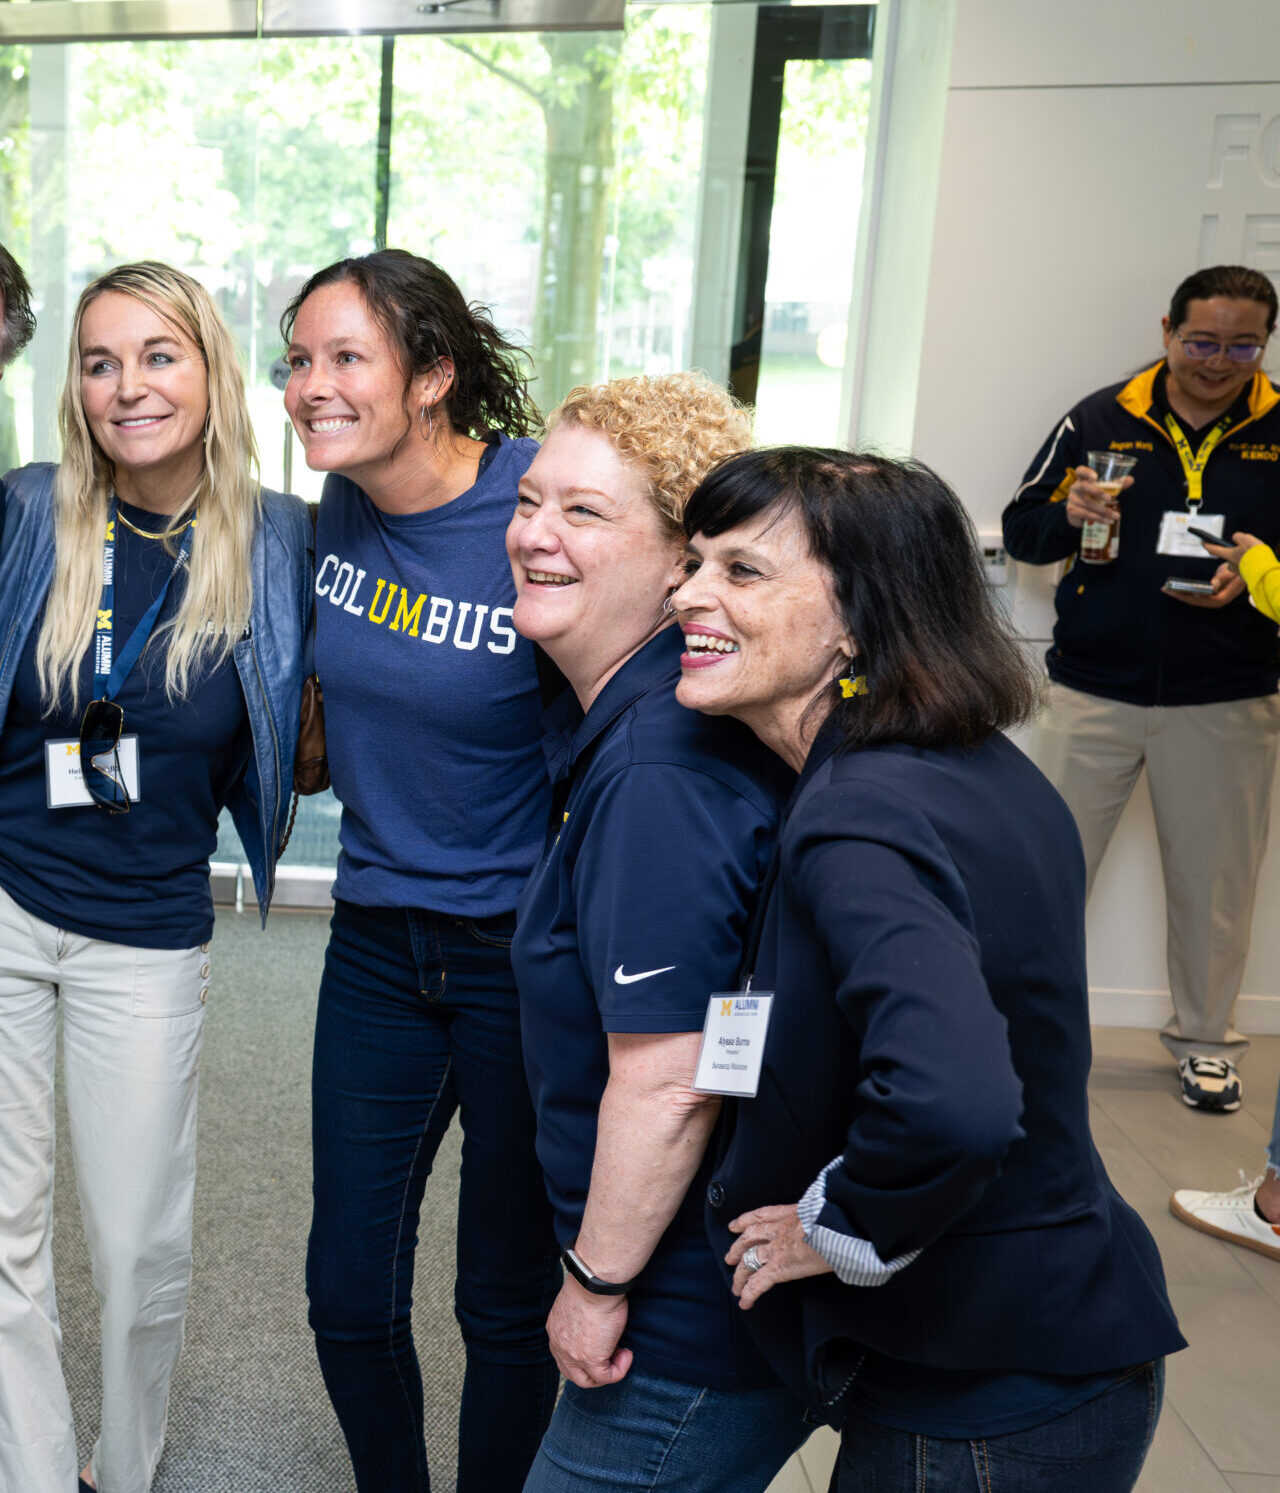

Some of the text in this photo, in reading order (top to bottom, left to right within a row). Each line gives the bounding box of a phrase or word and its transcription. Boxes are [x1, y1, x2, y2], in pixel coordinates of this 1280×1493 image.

[102, 547, 114, 586] ALUMNI
[315, 553, 517, 655] COLUMBUS
[100, 634, 113, 675] ALUMNI
[735, 999, 760, 1010] ALUMNI
